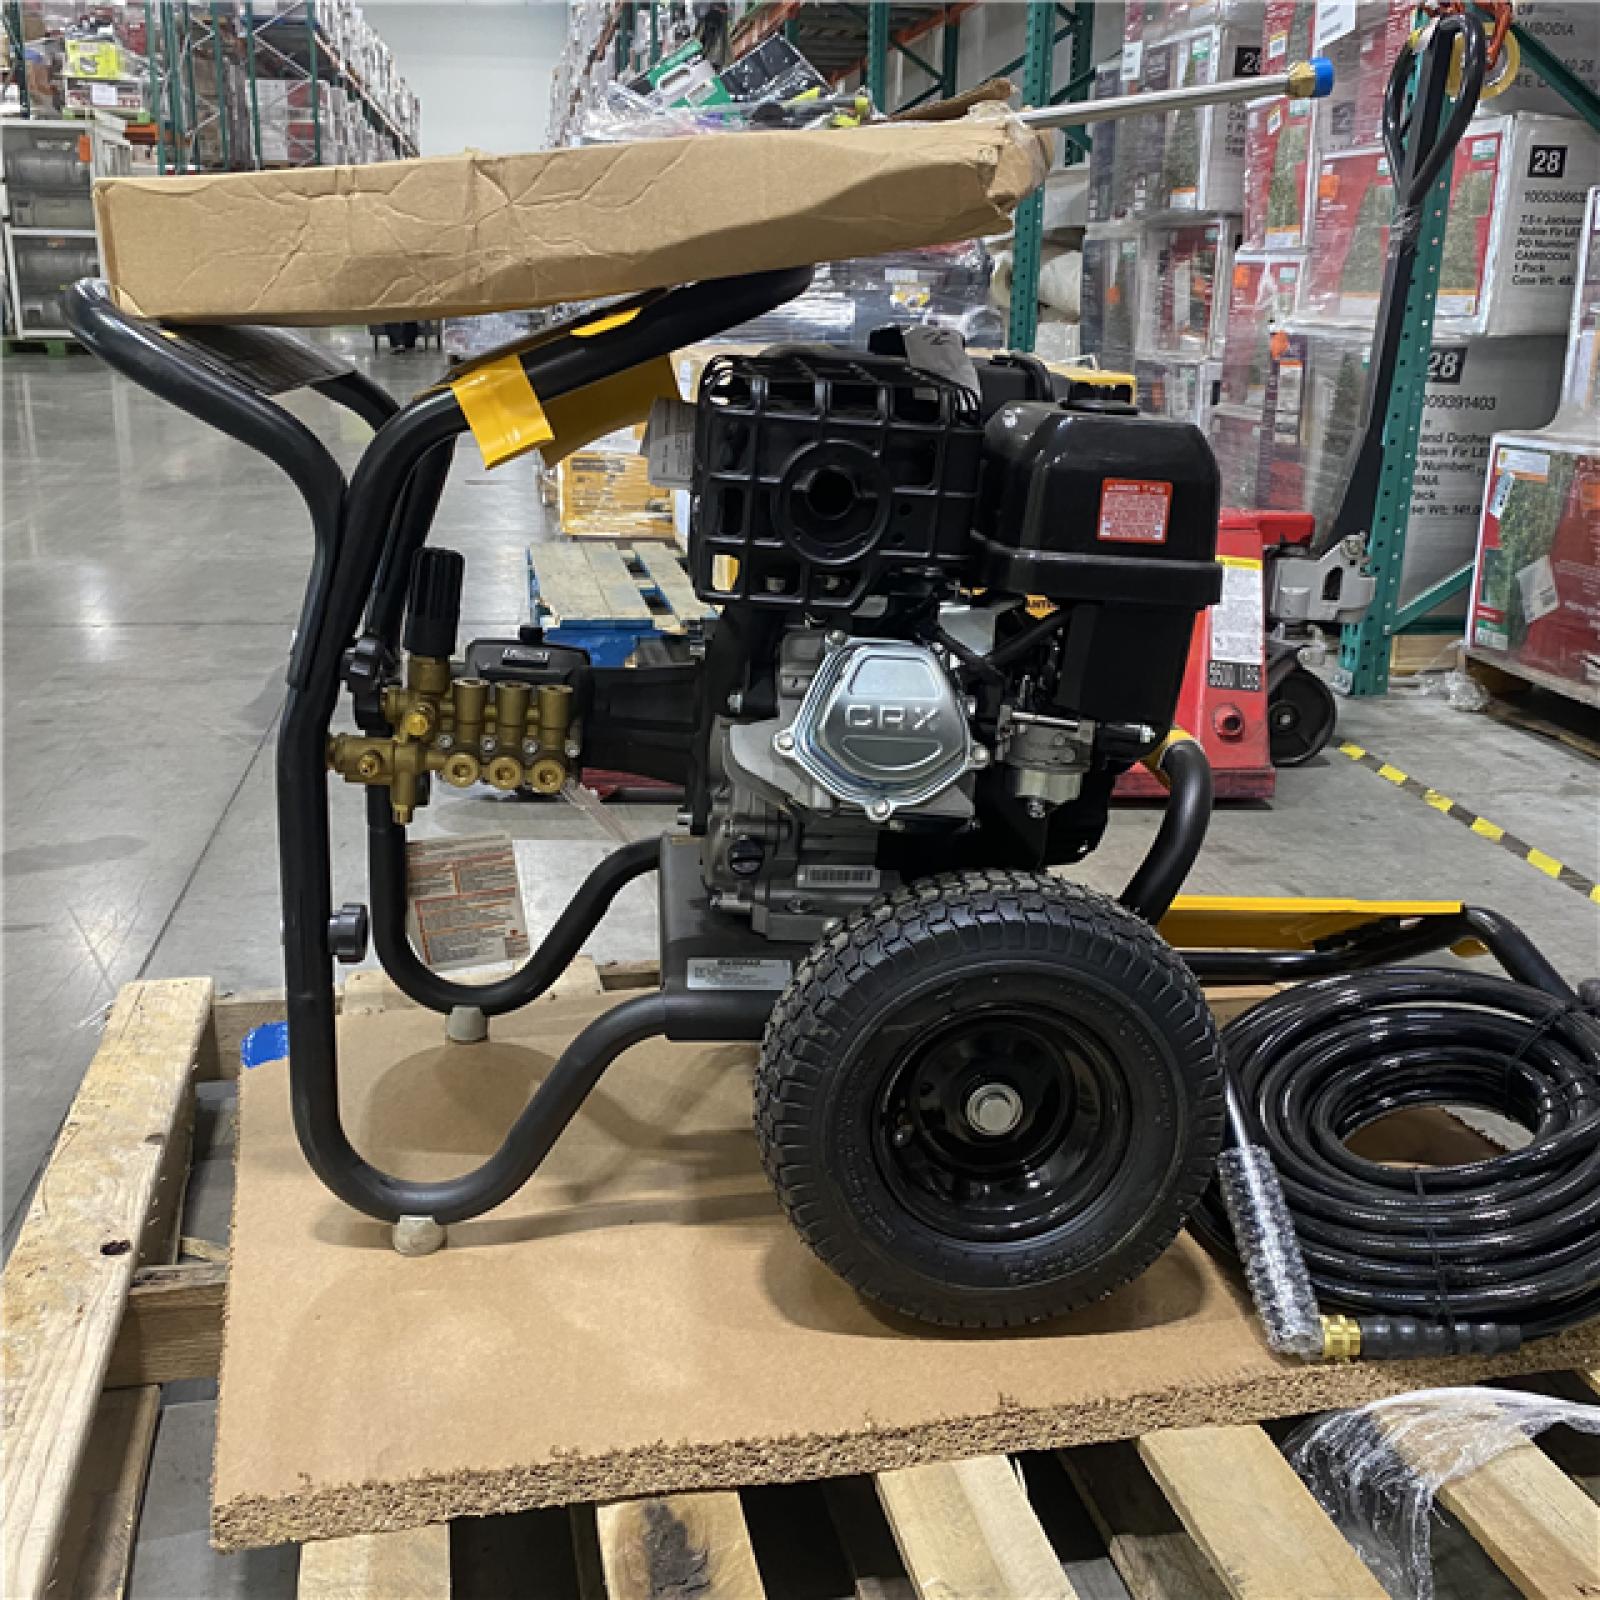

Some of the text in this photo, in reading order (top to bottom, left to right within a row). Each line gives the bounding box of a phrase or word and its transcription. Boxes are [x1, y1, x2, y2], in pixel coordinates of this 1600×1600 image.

[1534, 149, 1561, 173] 28
[1428, 351, 1458, 377] 28
[844, 704, 938, 732] CRX
